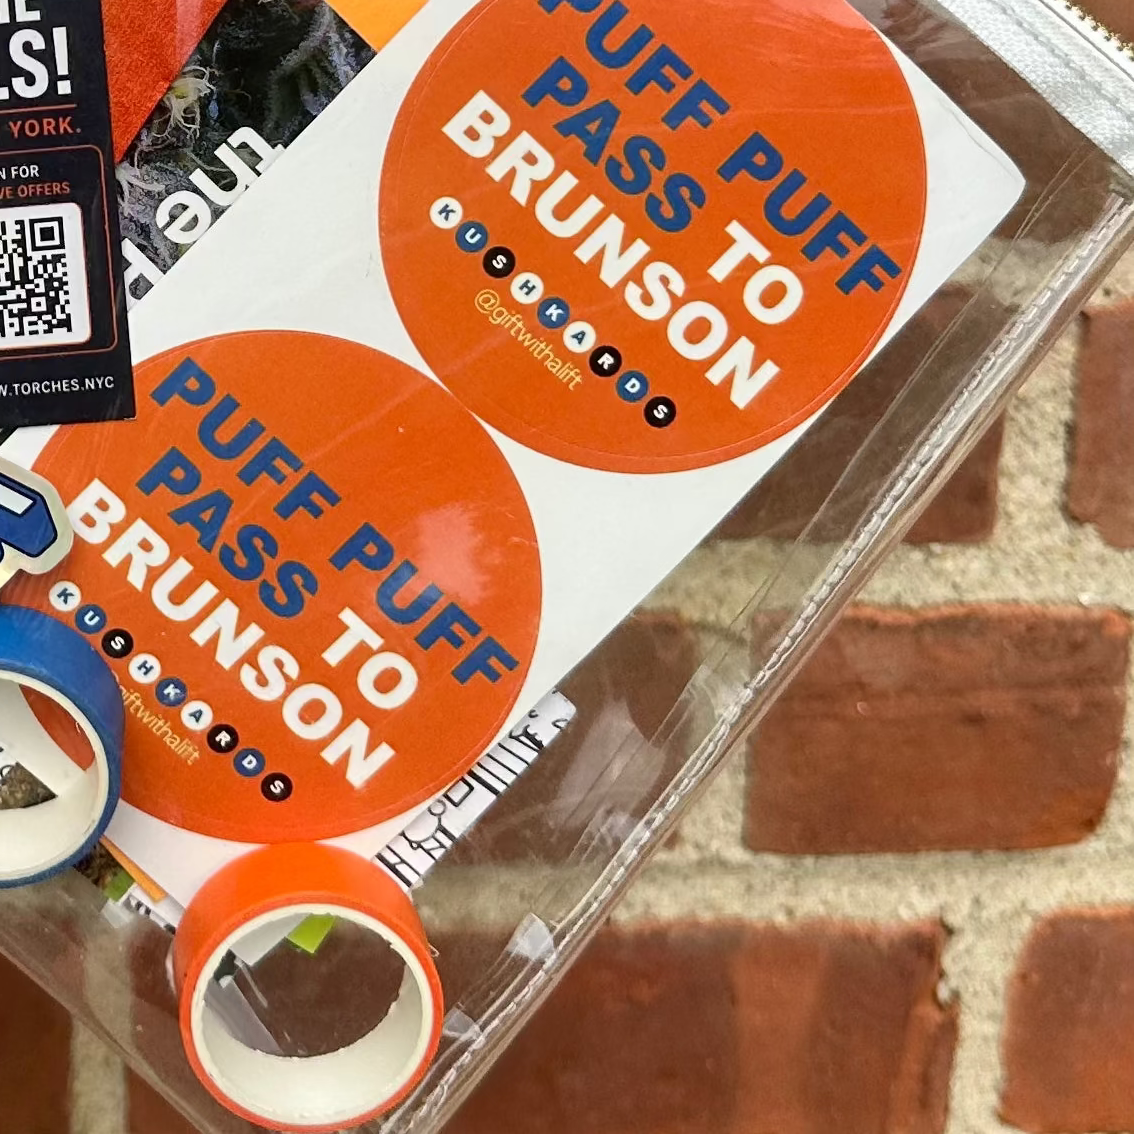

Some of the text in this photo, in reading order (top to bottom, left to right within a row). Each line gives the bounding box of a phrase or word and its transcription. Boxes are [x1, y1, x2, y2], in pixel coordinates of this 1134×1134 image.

[7, 116, 82, 138] YORK.
[10, 164, 40, 180] FOR
[17, 181, 71, 198] OFFERS
[521, 56, 804, 325] PASS TO
[717, 131, 903, 296] PUFF
[433, 199, 674, 425] KUSHKARDS
[441, 89, 780, 410] BRUNSON
[474, 288, 582, 390] @giftwithalift
[136, 446, 419, 710] PASS TO
[150, 357, 520, 685] PUFF PUFF
[50, 581, 293, 802] KUSHKARDS
[65, 477, 395, 790] BRUNSON
